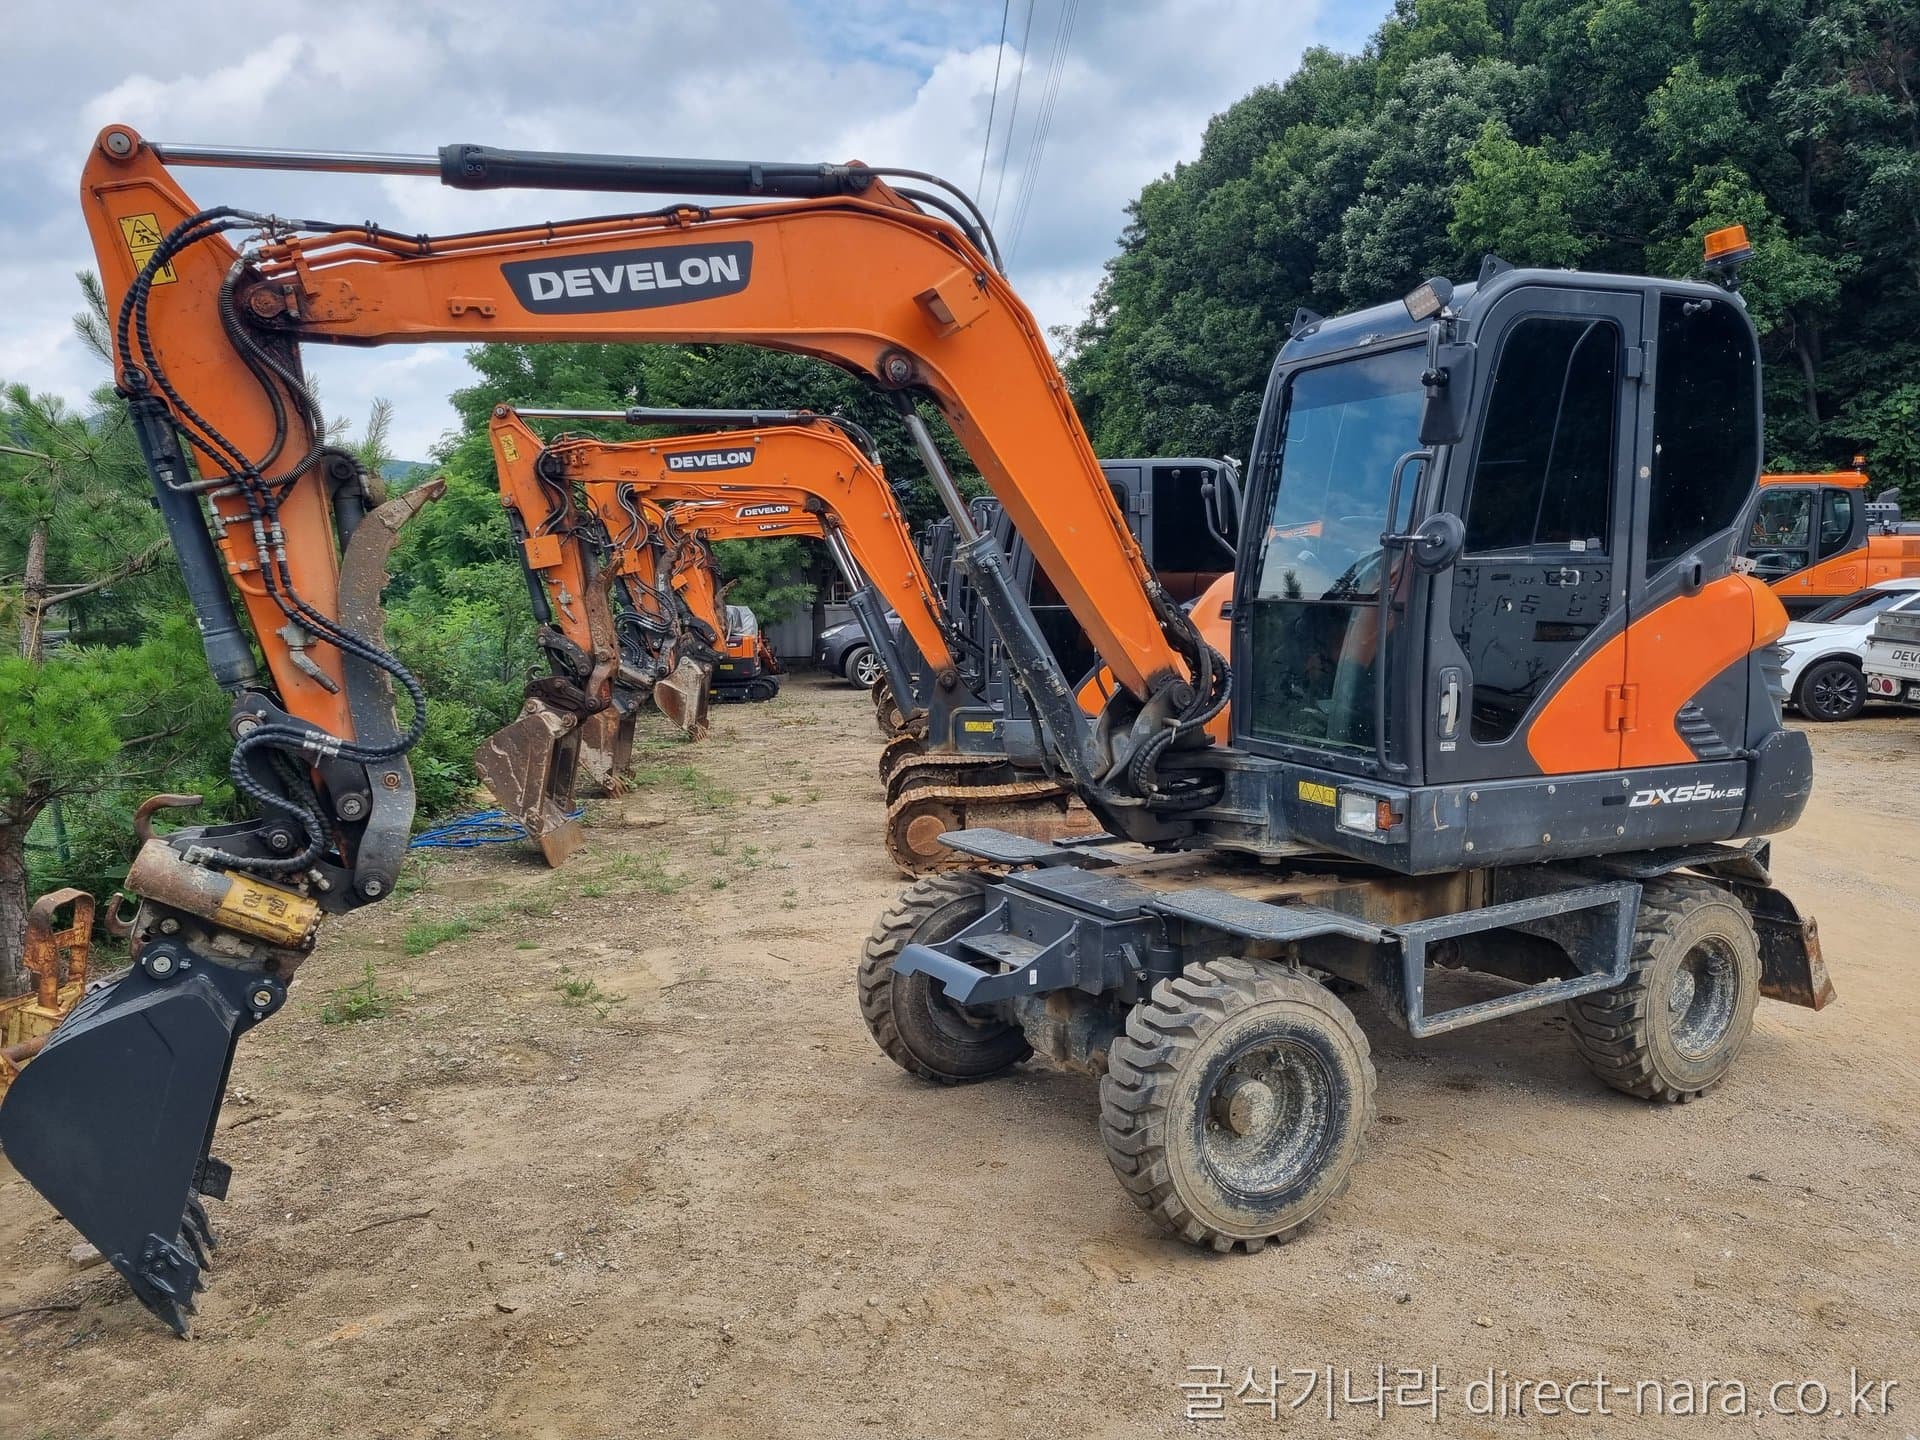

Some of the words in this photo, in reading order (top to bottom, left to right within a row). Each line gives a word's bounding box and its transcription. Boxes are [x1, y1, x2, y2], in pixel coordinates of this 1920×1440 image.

[527, 254, 741, 301] DEVELON
[669, 451, 752, 469] DEVELON
[744, 505, 789, 516] DEVELON
[1892, 650, 1920, 662] DEV
